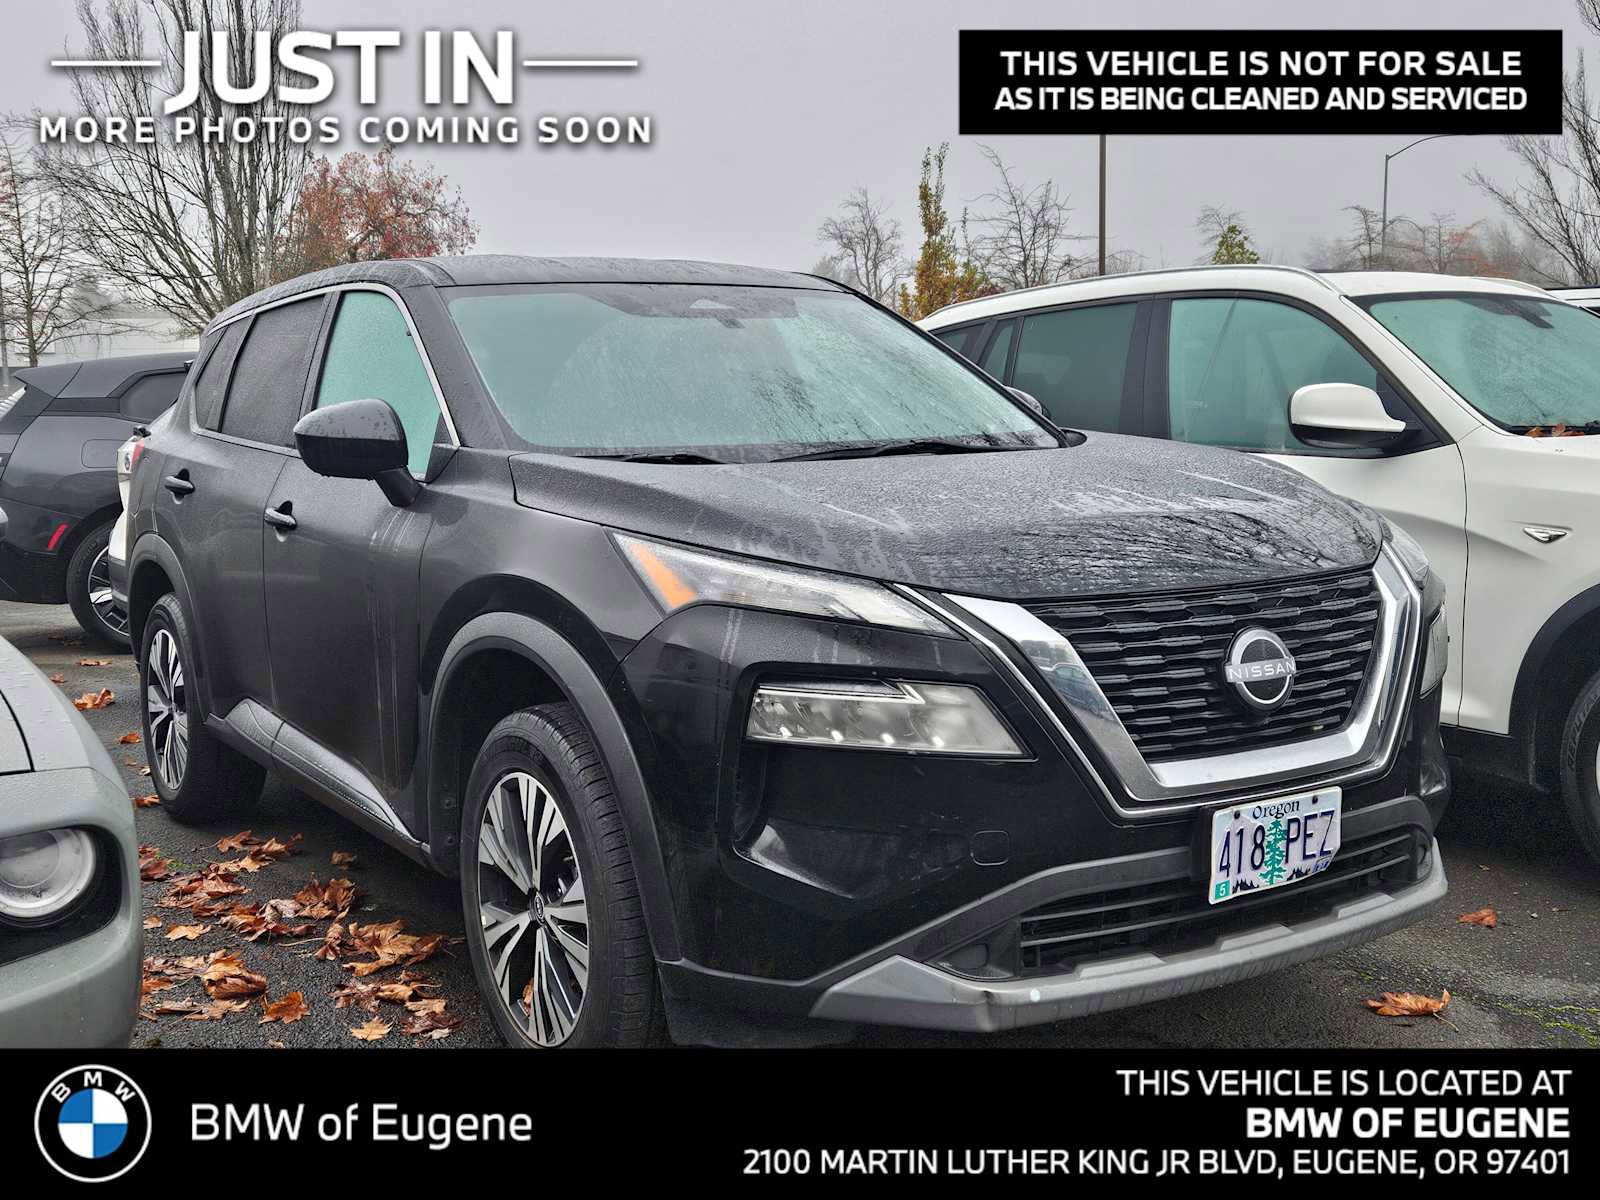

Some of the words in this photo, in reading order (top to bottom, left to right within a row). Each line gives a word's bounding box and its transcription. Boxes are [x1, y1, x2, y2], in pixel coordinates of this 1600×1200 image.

[1229, 661, 1296, 680] NISSAN
[1252, 801, 1299, 819] Oregon
[1219, 824, 1266, 877] 418
[1285, 810, 1335, 864] PEZ
[1219, 883, 1226, 896] 5
